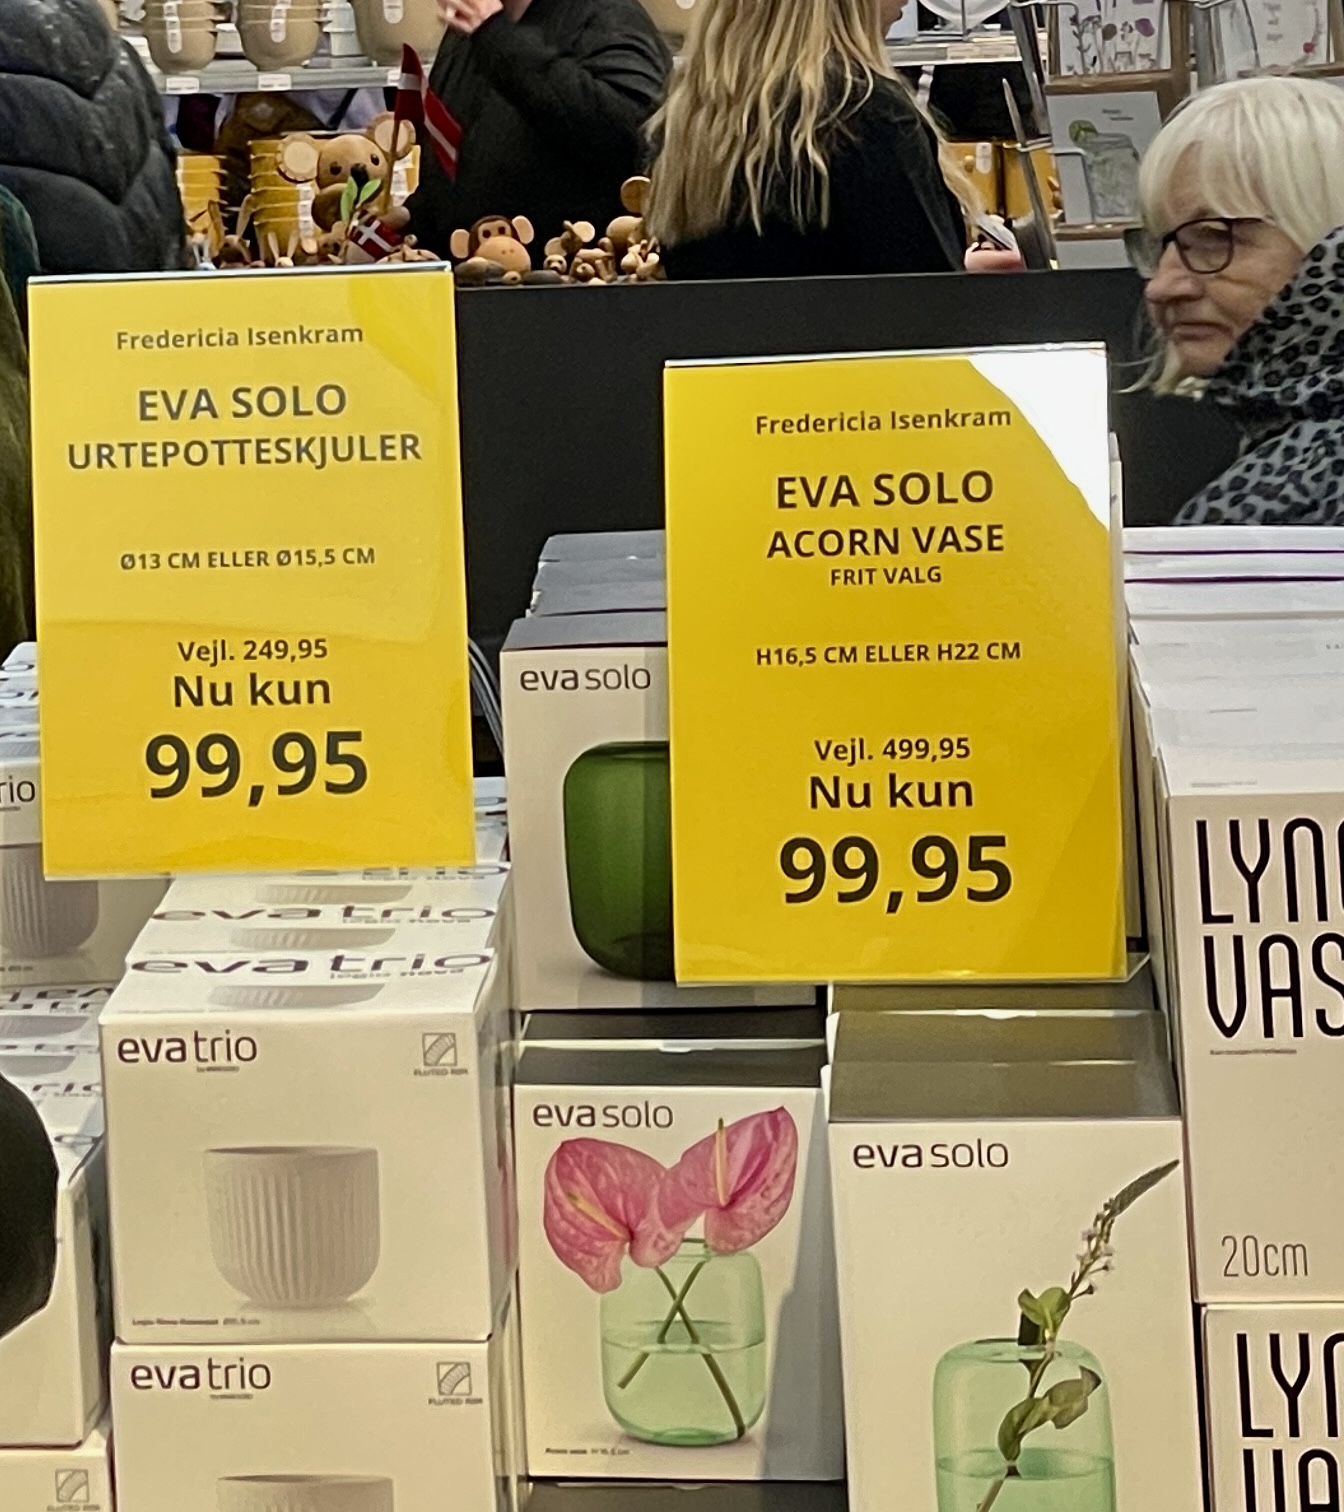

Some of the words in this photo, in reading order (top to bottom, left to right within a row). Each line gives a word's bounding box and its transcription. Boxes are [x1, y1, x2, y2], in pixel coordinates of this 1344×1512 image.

[118, 328, 238, 349] Fredericia
[248, 325, 362, 345] Isenkram
[140, 389, 218, 421] EVA
[232, 385, 346, 418] SOLO
[757, 411, 880, 434] Fredericia
[892, 409, 1010, 429] Isenkram
[69, 434, 421, 469] URTEPOTTESKJULER
[778, 475, 859, 508] EVA
[874, 471, 992, 506] SOLO
[767, 528, 899, 558] ACORN
[912, 525, 1003, 553] VASE
[121, 554, 160, 570] Ø13
[168, 552, 199, 568] CM
[208, 551, 269, 567] ELLER
[277, 549, 335, 567] Ø15,5
[343, 548, 374, 564] CM
[832, 568, 876, 585] FRIT
[883, 566, 941, 584] VALG
[178, 639, 234, 667] Vejl.
[244, 639, 327, 662] 249,95
[757, 647, 816, 666] H16,5
[824, 647, 857, 663] CM
[866, 645, 929, 662] ELLER
[938, 643, 979, 660] H22
[987, 642, 1020, 659] CM
[175, 676, 232, 707] Nu
[250, 673, 330, 705] kun
[146, 731, 367, 807] 99,95
[815, 738, 873, 766] Vejl.
[883, 738, 970, 762] 499,95
[811, 776, 870, 809] Nu
[889, 773, 972, 807] kun
[781, 836, 1011, 913] 99,95
[1196, 818, 1344, 924] LYN
[1221, 1235, 1309, 1278] 20cm
